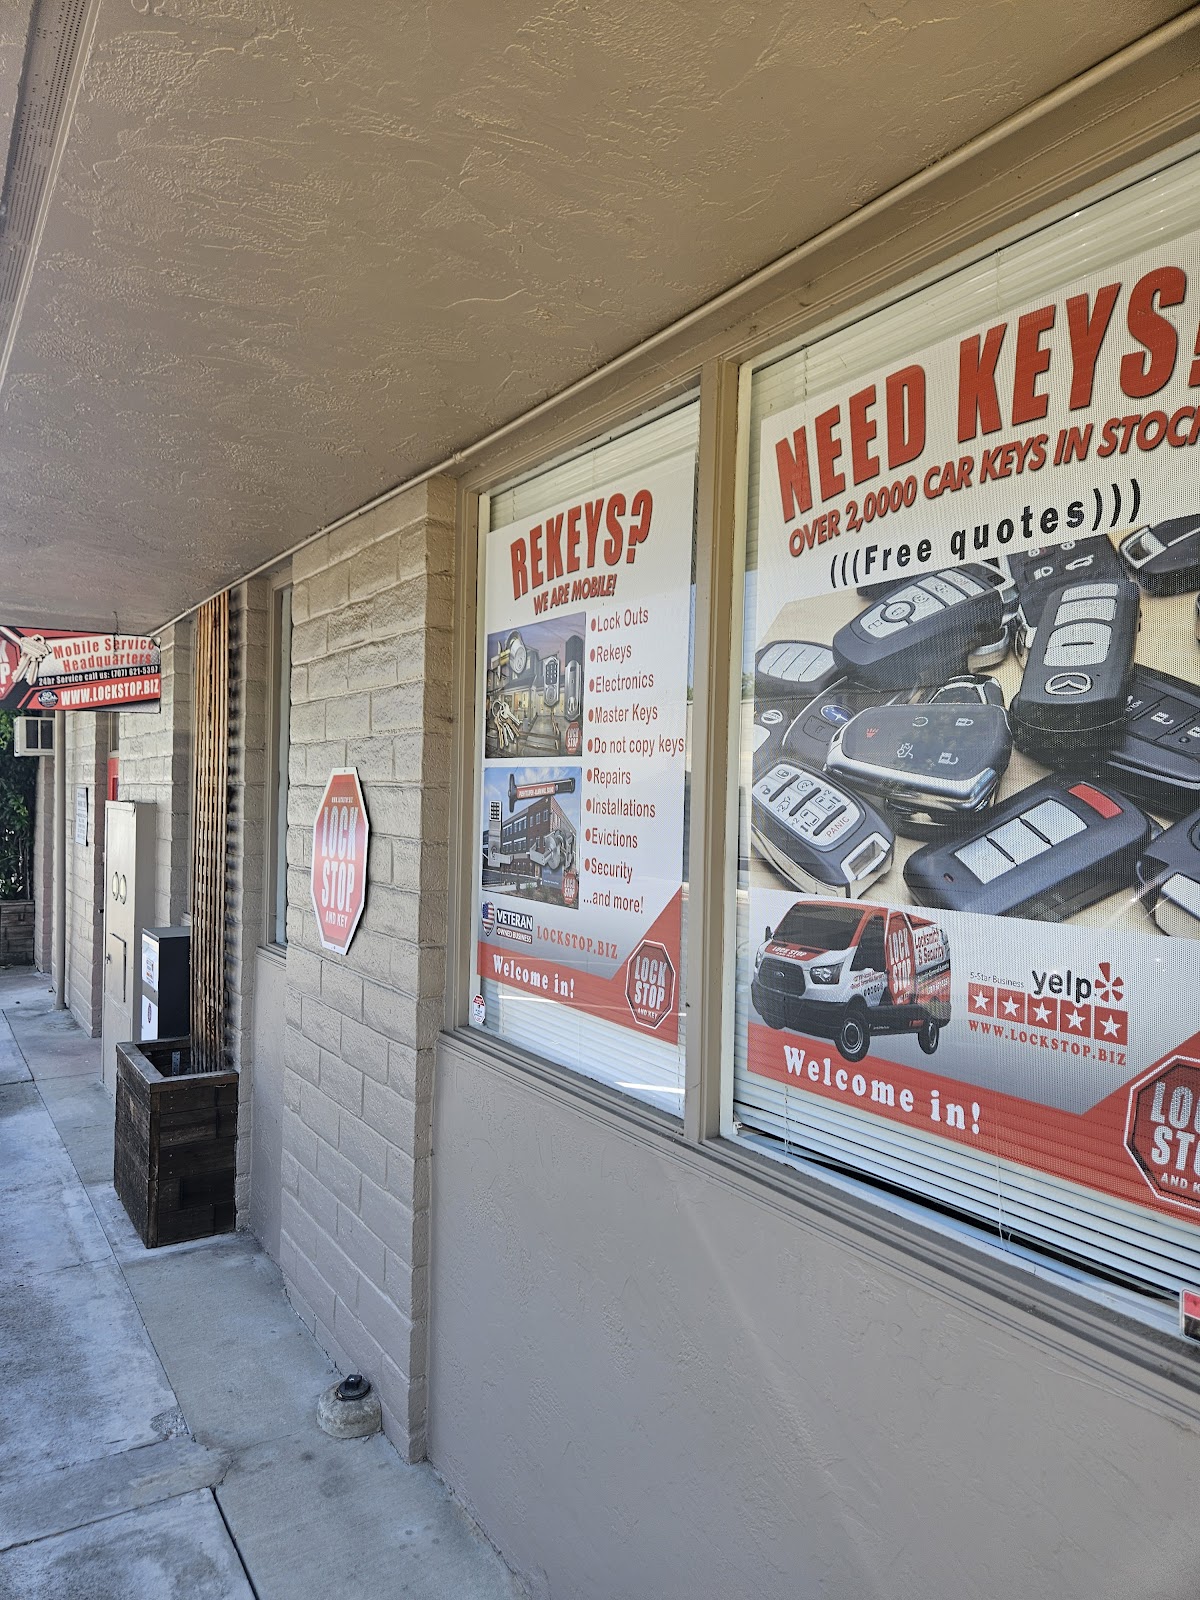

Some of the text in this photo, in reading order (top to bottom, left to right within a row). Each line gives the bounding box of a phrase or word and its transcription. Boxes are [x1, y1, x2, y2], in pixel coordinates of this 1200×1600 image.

[775, 266, 1200, 523] NEED KEYS
[789, 511, 840, 558] OVER
[845, 475, 917, 532] 2,0000
[923, 456, 974, 499] CAR
[980, 433, 1047, 484] KEYS
[1053, 423, 1093, 466] IN
[510, 489, 653, 601] REKEYS?
[533, 573, 618, 616] WE ARE MOBILE!
[597, 606, 649, 633] Lock Outs
[53, 637, 155, 660] Mobile Service
[596, 643, 632, 664] Rekeys
[62, 652, 151, 673] Headquarters
[38, 676, 56, 686] 24hr
[56, 675, 83, 685] Service
[84, 671, 98, 681] call
[595, 671, 654, 693] Electronics
[60, 678, 159, 706] WWW.LOCKSTOP.BIZ
[594, 703, 658, 725] Master Keys
[594, 734, 684, 758] Do not copy keys
[593, 767, 631, 789] Repairs
[592, 797, 656, 818] Installations
[321, 806, 359, 861] LOCK
[591, 827, 638, 849] Evictions
[825, 816, 850, 838] PANIC
[591, 857, 633, 884] Security
[613, 895, 644, 915] more!
[325, 910, 348, 929] AND KEY
[496, 909, 533, 930] VETERAN
[496, 927, 513, 939] OWNED
[536, 925, 618, 960] LOCKSTOP.BIZ
[889, 928, 911, 966] LOCK
[492, 953, 575, 999] Welcome in!
[634, 955, 667, 988] LOCK
[893, 959, 912, 994] STOP
[992, 975, 1025, 988] Business
[634, 980, 665, 1011] STOP
[1031, 969, 1092, 1004] yelp
[637, 1007, 659, 1020] AND KEY
[968, 1019, 1127, 1066] WWW.LOCKSTOP.BIZ
[783, 1045, 981, 1135] Welcome in!
[1160, 1172, 1188, 1189] AND
